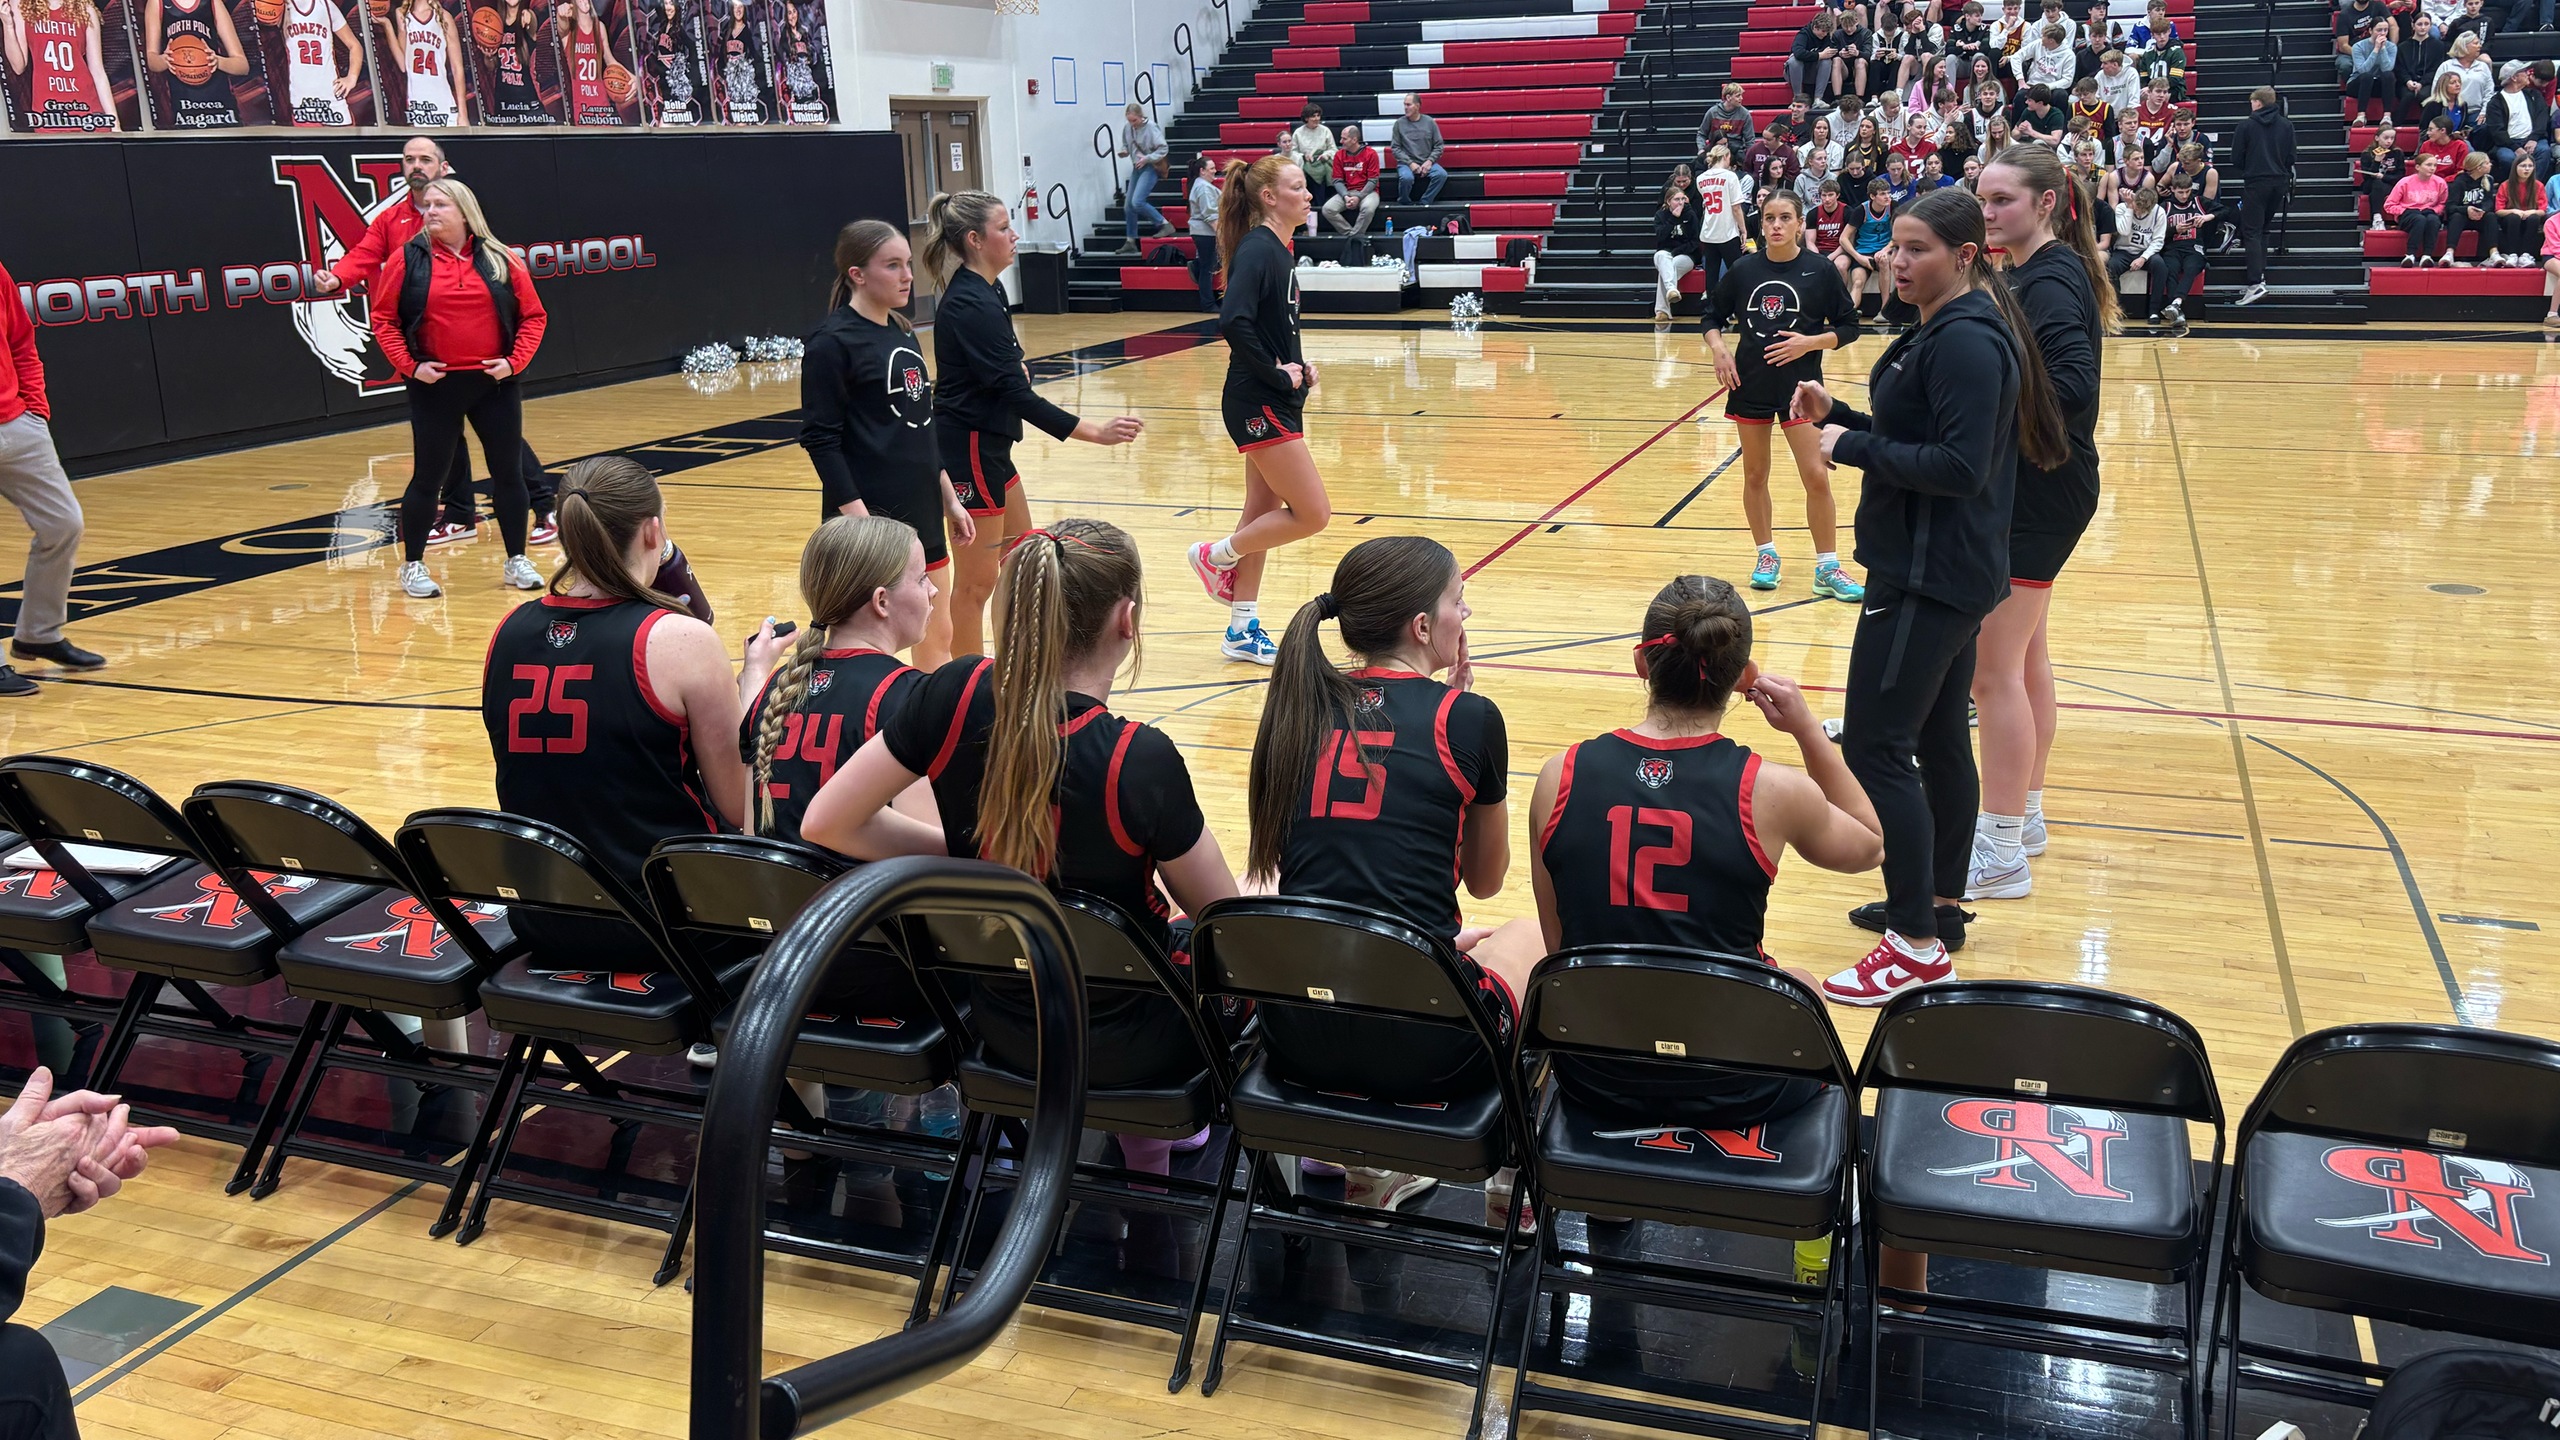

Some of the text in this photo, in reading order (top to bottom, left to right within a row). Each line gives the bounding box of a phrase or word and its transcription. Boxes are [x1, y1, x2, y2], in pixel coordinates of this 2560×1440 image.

[34, 20, 77, 37] NORTH
[166, 20, 212, 39] NORTH POLK
[287, 22, 328, 39] COMETS
[408, 31, 442, 49] COMETS
[298, 40, 323, 65] 22
[575, 42, 598, 54] NORT
[44, 40, 74, 72] 40
[413, 48, 439, 76] 24
[498, 47, 522, 72] 23
[578, 58, 597, 81] 20
[2150, 60, 2168, 79] 10
[48, 76, 79, 92] POLK
[501, 72, 525, 86] POLK
[581, 84, 599, 96] POLK
[44, 100, 89, 111] Greta
[180, 100, 224, 110] Becca
[300, 98, 331, 109] Abby
[410, 101, 438, 111] Jada
[500, 102, 531, 111] Lucia
[582, 104, 615, 113] Lauren
[664, 100, 687, 110] Bella
[729, 101, 758, 111] Brooke
[791, 102, 823, 111] Meredith
[25, 112, 116, 130] Dillinger
[175, 110, 238, 128] Aagard
[293, 108, 343, 123] Tuttle
[405, 111, 449, 127] Podey
[485, 113, 556, 124] Soriano-Botella
[578, 114, 623, 125] Ausborn
[731, 112, 759, 123] Welch
[1975, 124, 1988, 136] BLA
[1703, 191, 1723, 215] 25
[1818, 223, 1841, 231] MIAMI
[1827, 230, 1839, 238] 22
[2131, 233, 2145, 246] 21
[222, 261, 368, 308] POL
[507, 664, 594, 754] 25
[759, 713, 845, 800] 24
[1309, 729, 1396, 821] 15
[1606, 805, 1694, 913] 12
[1312, 988, 1329, 997] clarin
[1661, 1042, 1680, 1051] clarin
[2020, 1080, 2042, 1090] clarin
